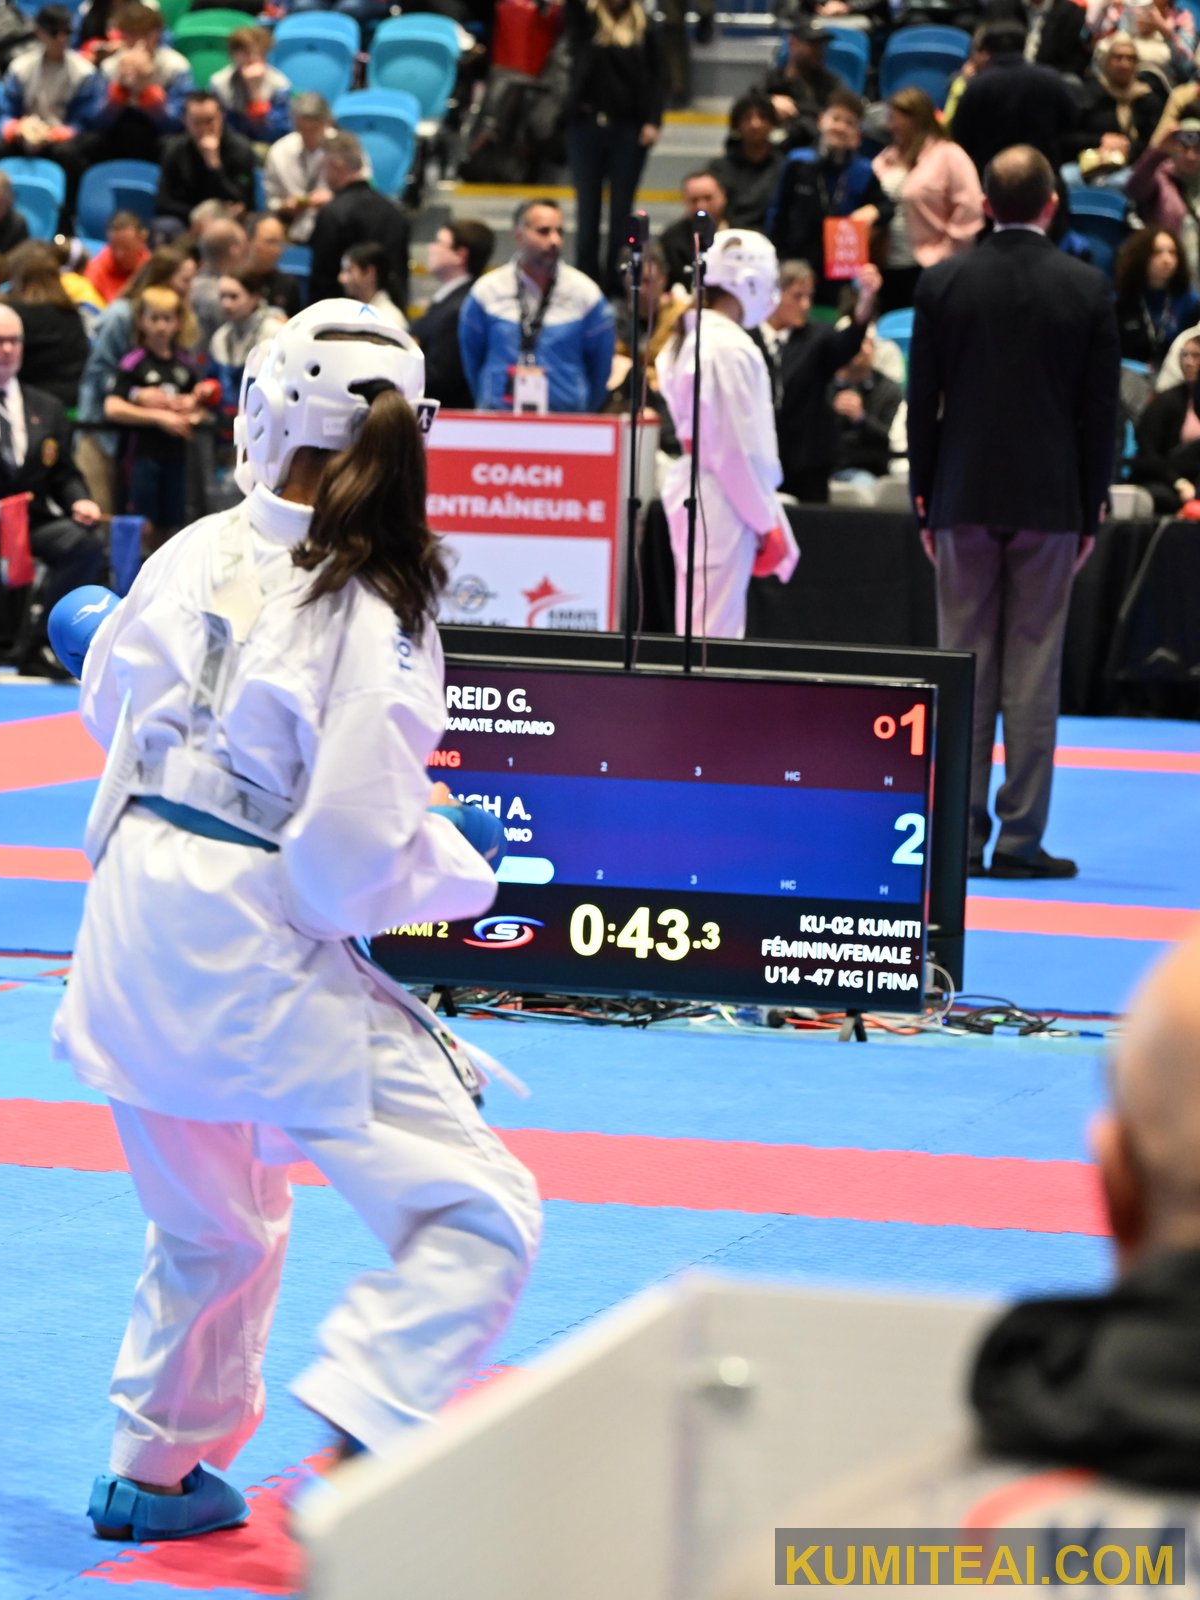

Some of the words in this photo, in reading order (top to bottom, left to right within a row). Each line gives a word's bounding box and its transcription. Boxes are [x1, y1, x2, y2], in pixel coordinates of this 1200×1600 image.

[471, 462, 564, 488] COACH
[446, 685, 501, 711] REID
[506, 688, 532, 713] G.
[445, 717, 493, 733] KARATE
[494, 720, 555, 736] ONTARIO
[424, 750, 461, 768] ING
[507, 757, 514, 767] 1
[600, 762, 608, 773] 2
[695, 766, 702, 777] 3
[785, 771, 801, 781] HC
[884, 776, 893, 786] H
[506, 796, 532, 821] A.
[892, 813, 926, 865] 2
[595, 869, 604, 880] 2
[691, 875, 698, 885] 3
[780, 880, 797, 890] HC
[879, 885, 889, 895] H
[437, 921, 449, 938] 2
[569, 903, 721, 961] 0:43.3
[800, 915, 854, 935] KU-02
[761, 935, 912, 965] FÉMININ/FEMALE
[764, 965, 801, 985] U14
[803, 968, 834, 986] -47
[837, 970, 864, 989] KG
